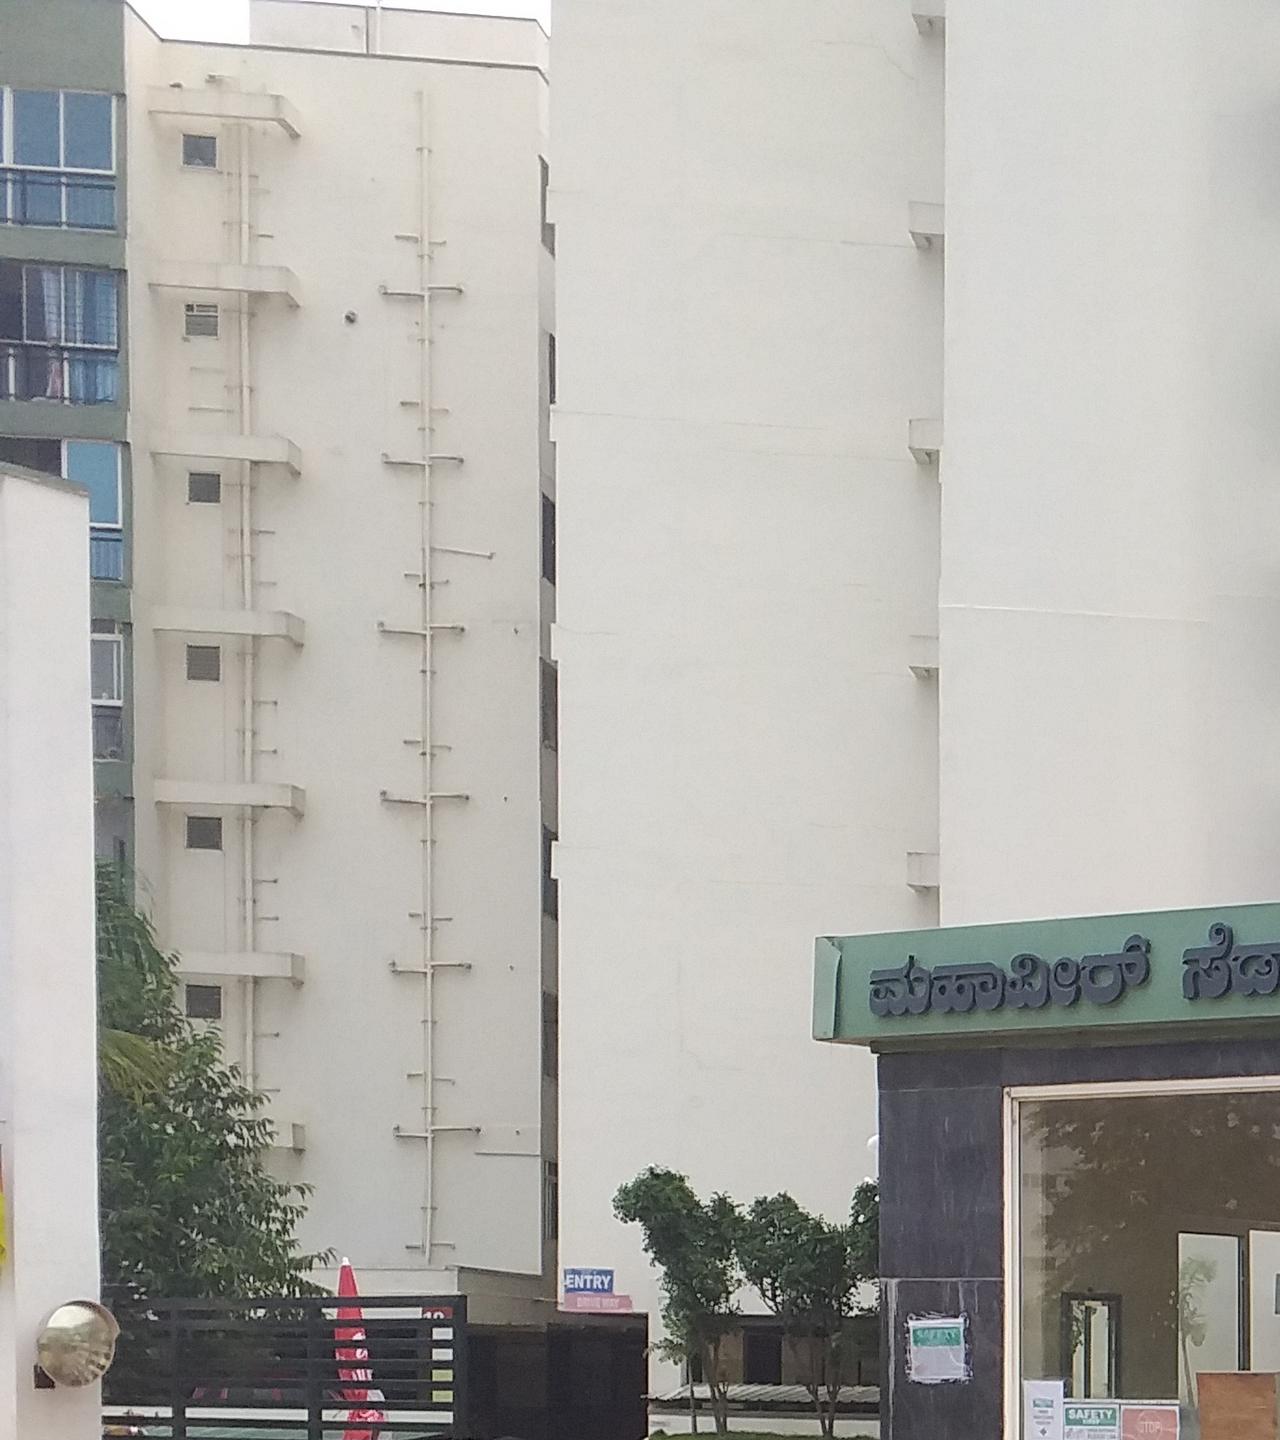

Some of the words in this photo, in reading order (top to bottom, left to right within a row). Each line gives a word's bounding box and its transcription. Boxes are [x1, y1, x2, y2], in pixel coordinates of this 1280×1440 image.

[869, 933, 1152, 1018] ಮಹಾವೀರ್
[565, 1274, 612, 1290] ENTRY
[1068, 1408, 1113, 1420] SAFETY
